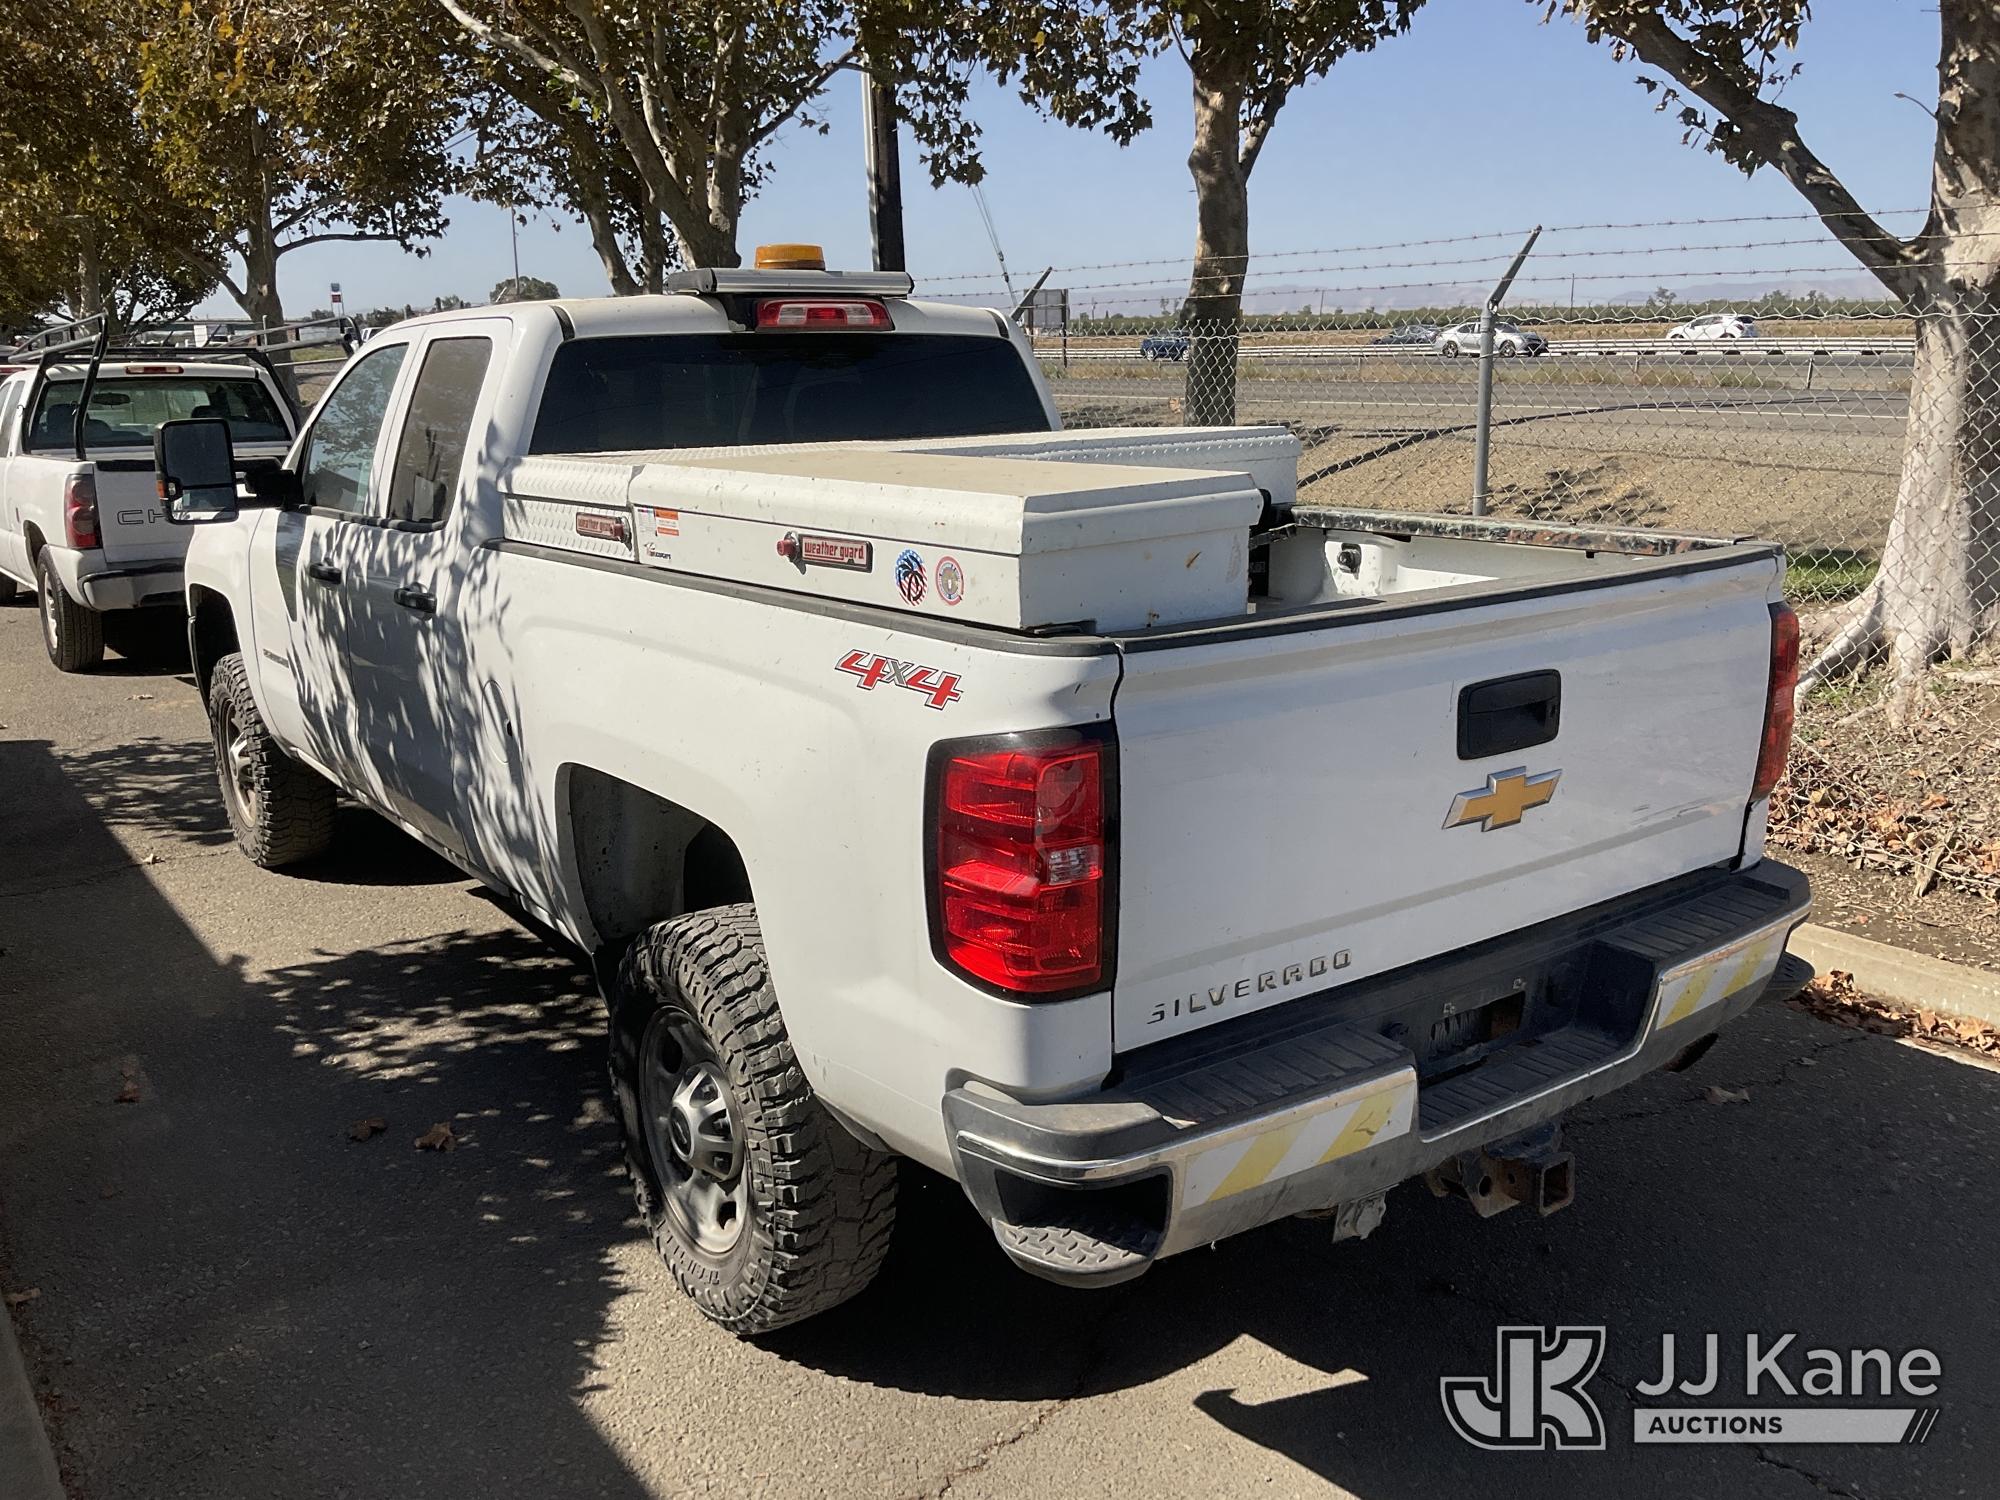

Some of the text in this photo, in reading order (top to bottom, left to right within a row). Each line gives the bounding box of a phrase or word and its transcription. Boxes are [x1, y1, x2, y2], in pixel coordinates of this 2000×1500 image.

[804, 540, 865, 560] weather guard
[1147, 949, 1352, 1024] SILVERADO
